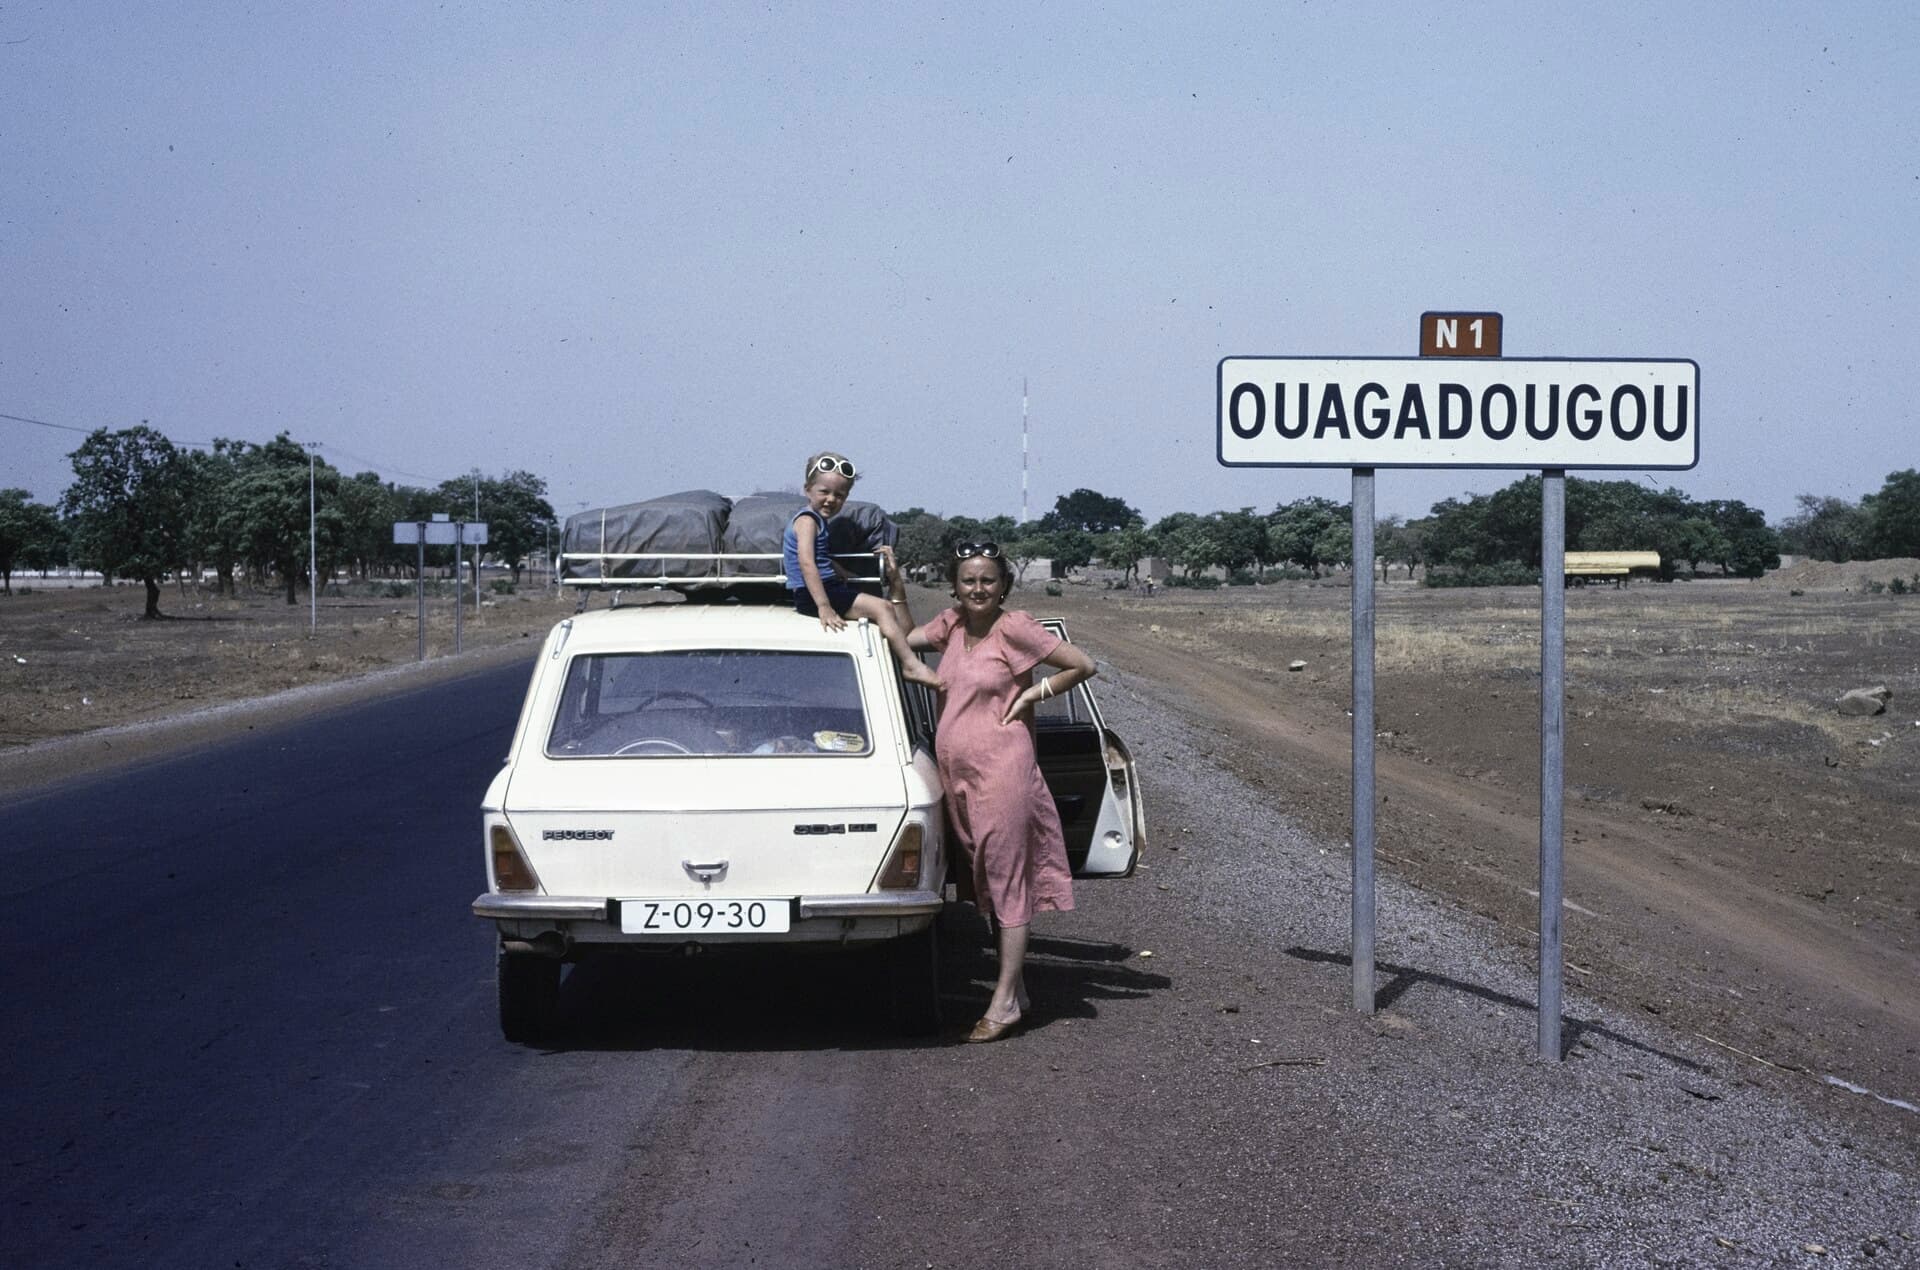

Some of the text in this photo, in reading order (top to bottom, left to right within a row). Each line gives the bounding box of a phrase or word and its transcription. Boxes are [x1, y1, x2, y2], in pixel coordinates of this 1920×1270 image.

[1436, 319, 1483, 348] N 1
[1229, 382, 1688, 441] OUAGADOUGOU
[543, 830, 615, 841] PEUGEOT
[643, 902, 766, 928] Z-09-30
